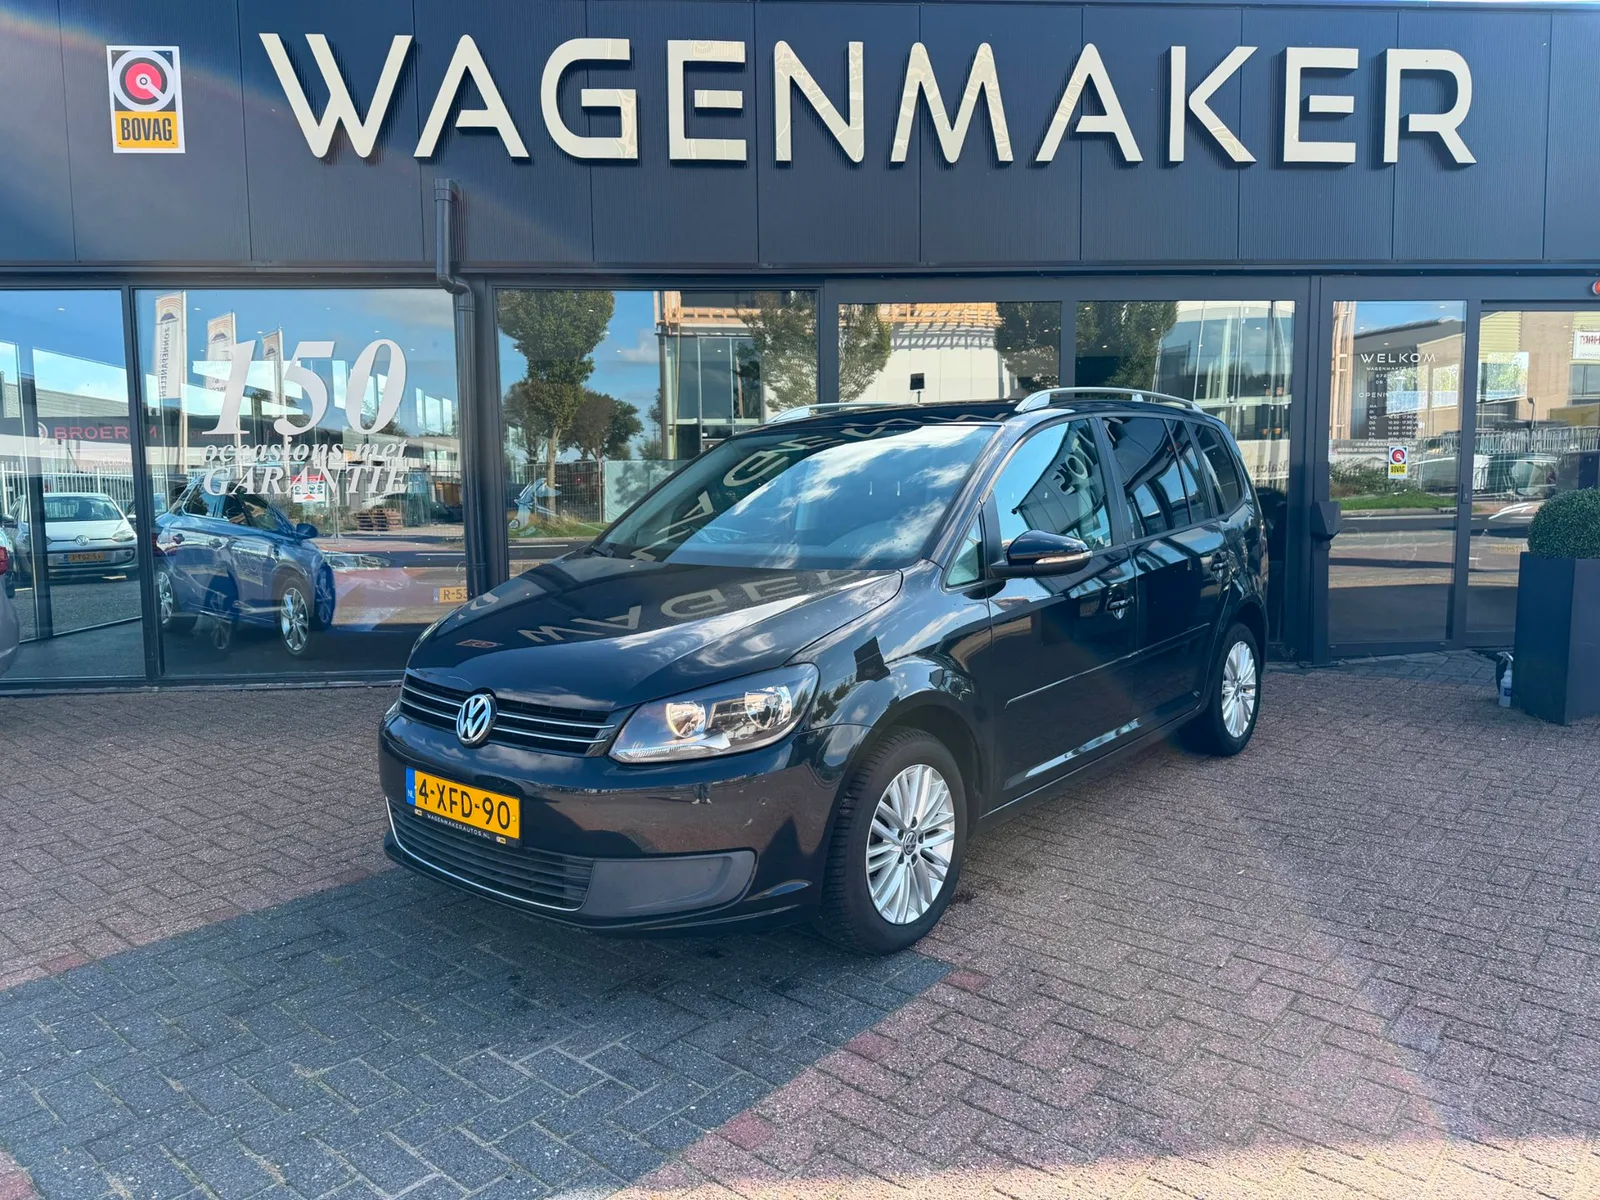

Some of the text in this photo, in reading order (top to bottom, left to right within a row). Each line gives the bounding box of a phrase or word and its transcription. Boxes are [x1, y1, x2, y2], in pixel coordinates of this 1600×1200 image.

[259, 33, 1477, 164] WAGENMAKER
[120, 117, 173, 142] BOVAG
[1360, 353, 1436, 363] WELKOM
[202, 338, 407, 436] 150
[201, 436, 410, 463] occasions met
[203, 465, 410, 497] GARANTIE
[419, 778, 511, 830] 4-XFD-90
[426, 813, 491, 839] WAGENMAKERAUTOS.NL
